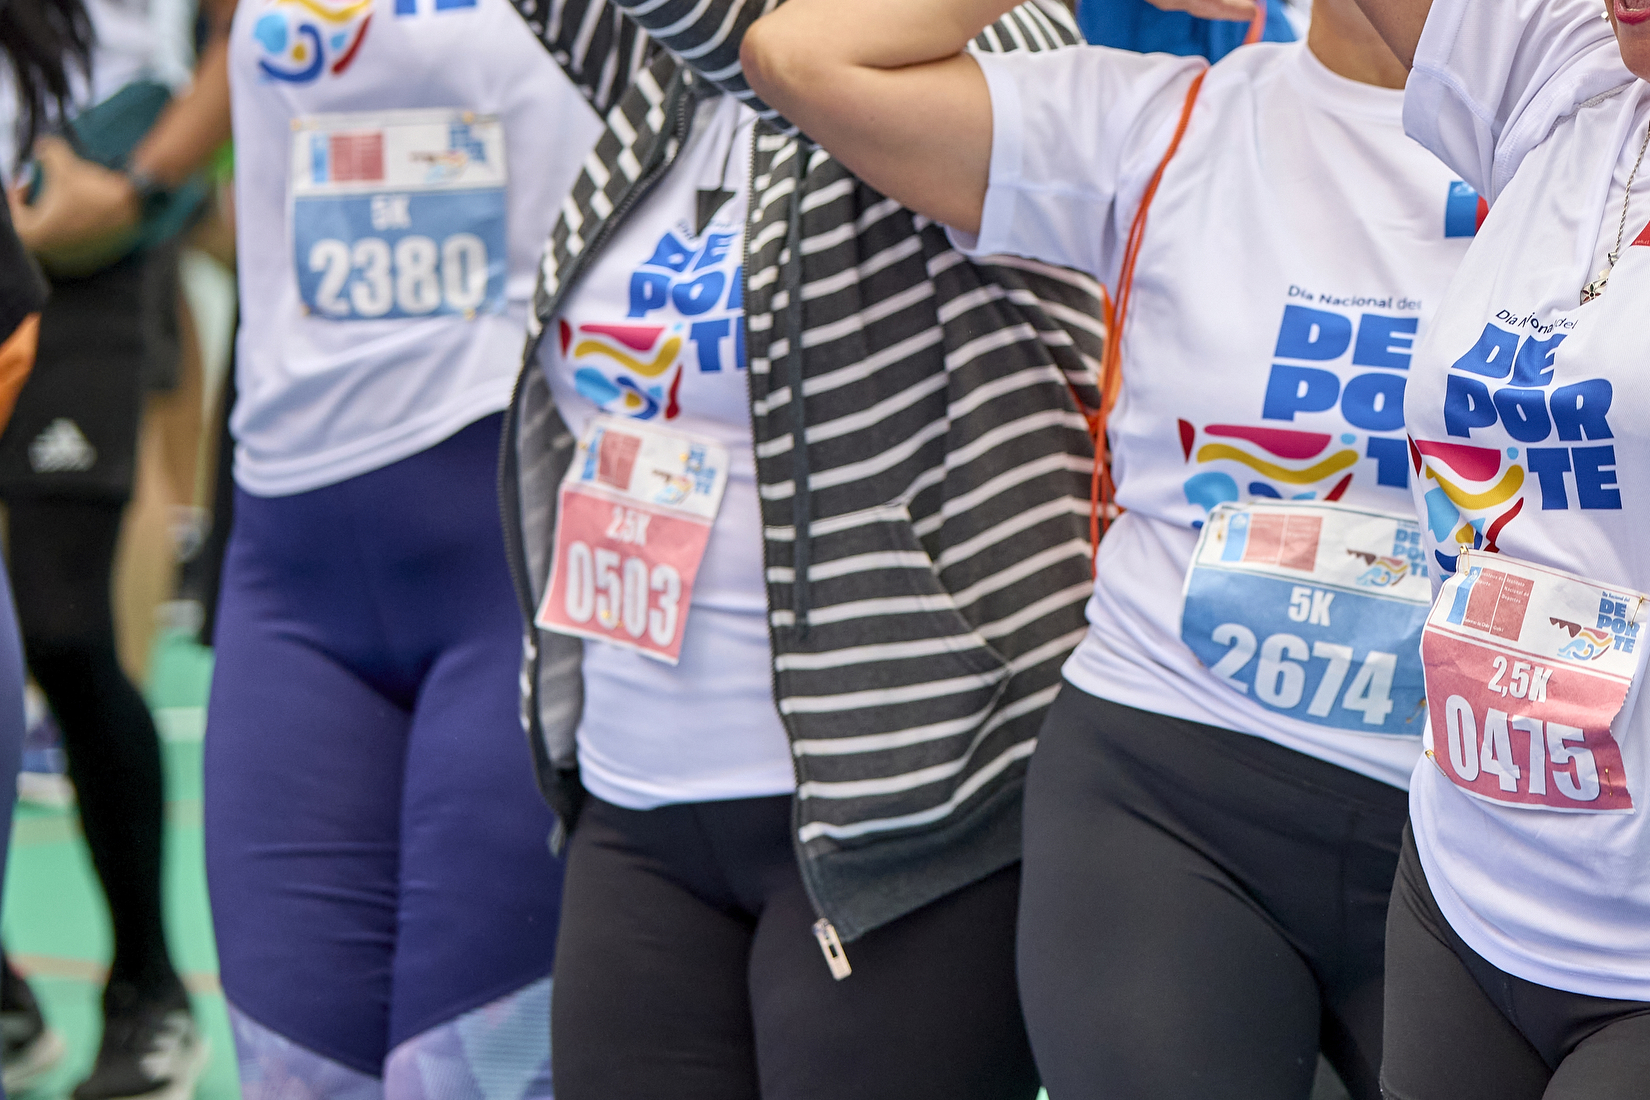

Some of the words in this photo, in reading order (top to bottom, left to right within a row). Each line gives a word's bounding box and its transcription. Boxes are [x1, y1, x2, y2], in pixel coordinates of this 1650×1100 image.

[371, 194, 413, 231] 5K
[308, 231, 490, 319] 2380
[642, 230, 738, 274] DE
[1288, 285, 1314, 301] Día
[1318, 294, 1392, 311] Nacional
[1396, 298, 1422, 311] del
[1496, 309, 1518, 326] Día
[1273, 304, 1419, 371] DE
[1451, 322, 1568, 388] DE
[1443, 378, 1615, 443] POR
[1526, 444, 1623, 511] TE
[563, 539, 682, 648] 0503
[1287, 585, 1335, 628] 5K
[1599, 597, 1627, 619] DE
[1596, 613, 1641, 638] POR
[1613, 634, 1636, 654] TE
[1209, 622, 1399, 726] 2674
[1487, 656, 1554, 703] 2,5K
[1445, 694, 1601, 802] 0475
